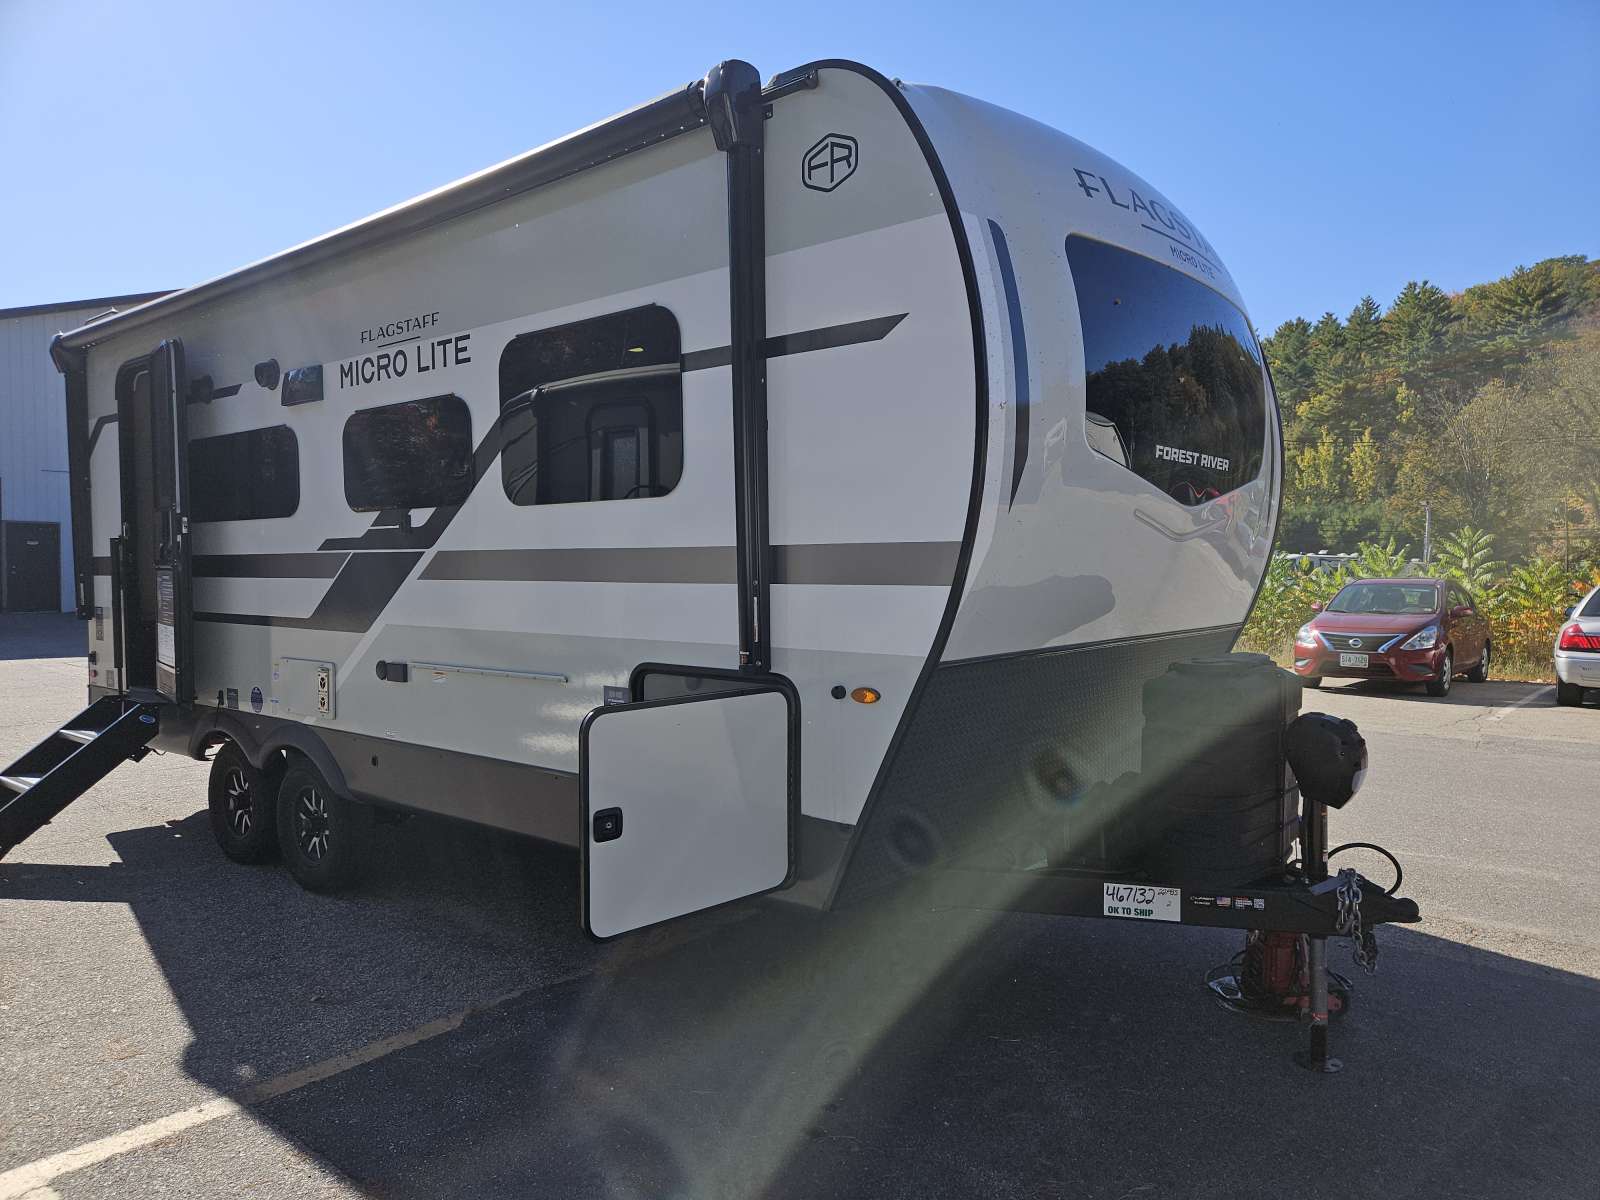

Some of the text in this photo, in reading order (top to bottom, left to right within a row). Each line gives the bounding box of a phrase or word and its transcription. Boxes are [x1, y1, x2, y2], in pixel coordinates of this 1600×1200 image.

[360, 311, 440, 344] FLAGSTAFF
[340, 333, 472, 389] MICRO LITE
[1155, 444, 1230, 472] FOREST RIVER
[1105, 885, 1155, 905] 467132
[1108, 905, 1153, 917] OK TO SHIP
